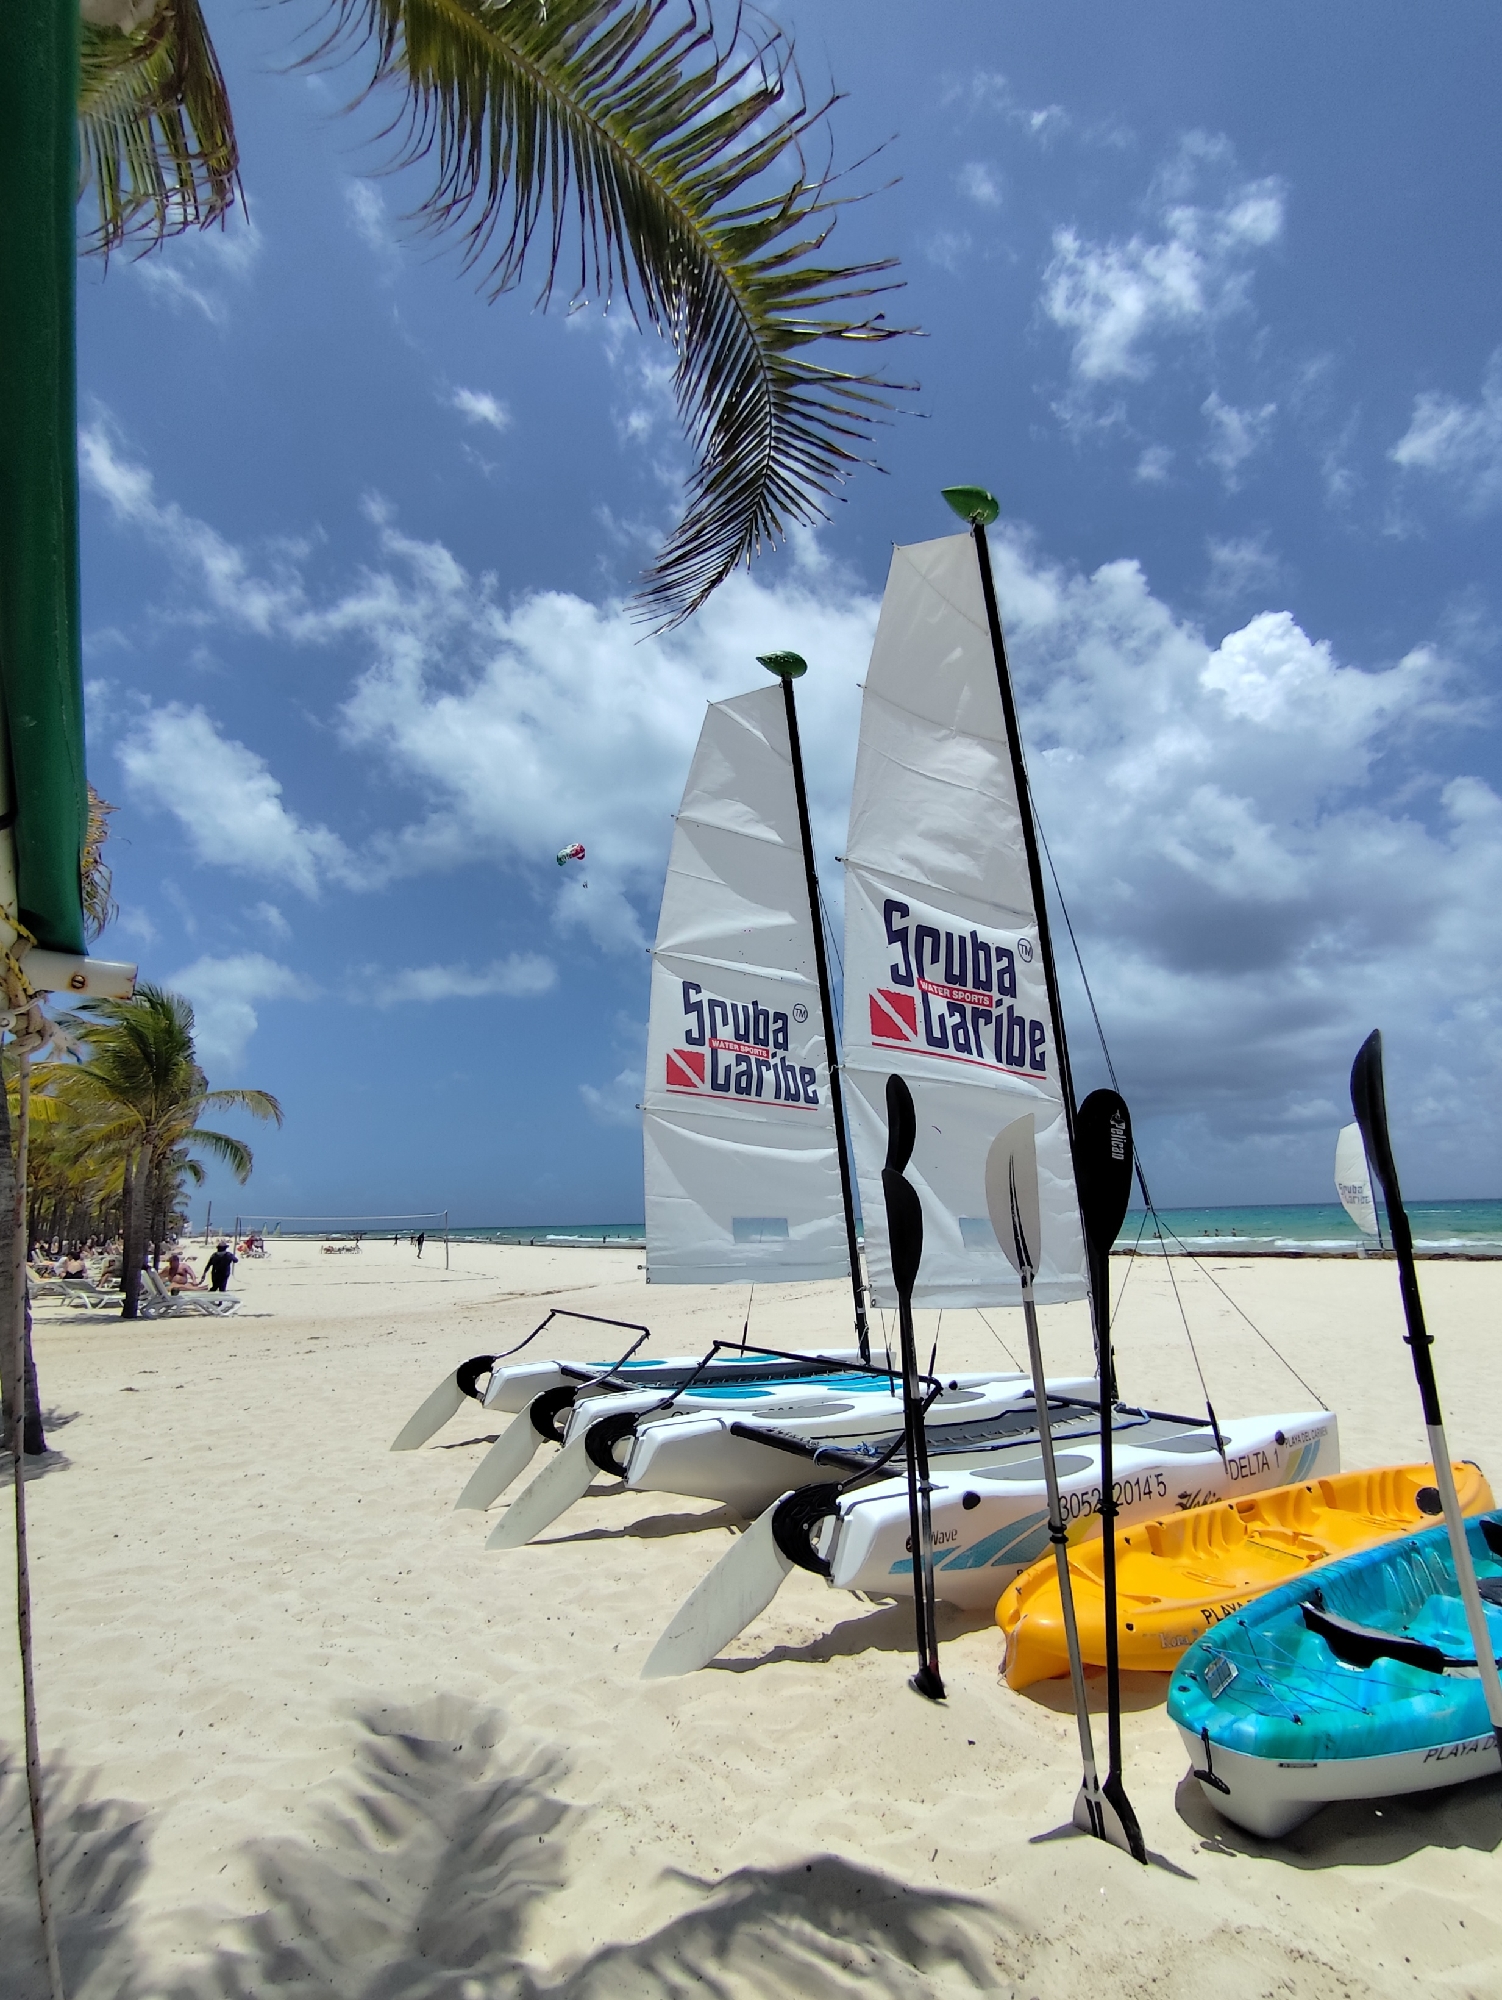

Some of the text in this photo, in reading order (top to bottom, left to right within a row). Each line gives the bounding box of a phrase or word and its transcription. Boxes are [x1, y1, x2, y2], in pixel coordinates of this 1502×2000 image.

[883, 898, 1017, 999] Scuba
[919, 979, 990, 1005] WATER SPORTS
[682, 980, 789, 1051] Scuba
[921, 988, 1046, 1071] Caribe
[711, 1039, 768, 1057] WATER SPORTS
[710, 1048, 819, 1104] Caribe
[1110, 1119, 1127, 1160] Pelican
[1228, 1448, 1280, 1481] DELTA 1
[1423, 1739, 1479, 1763] PLAYA
